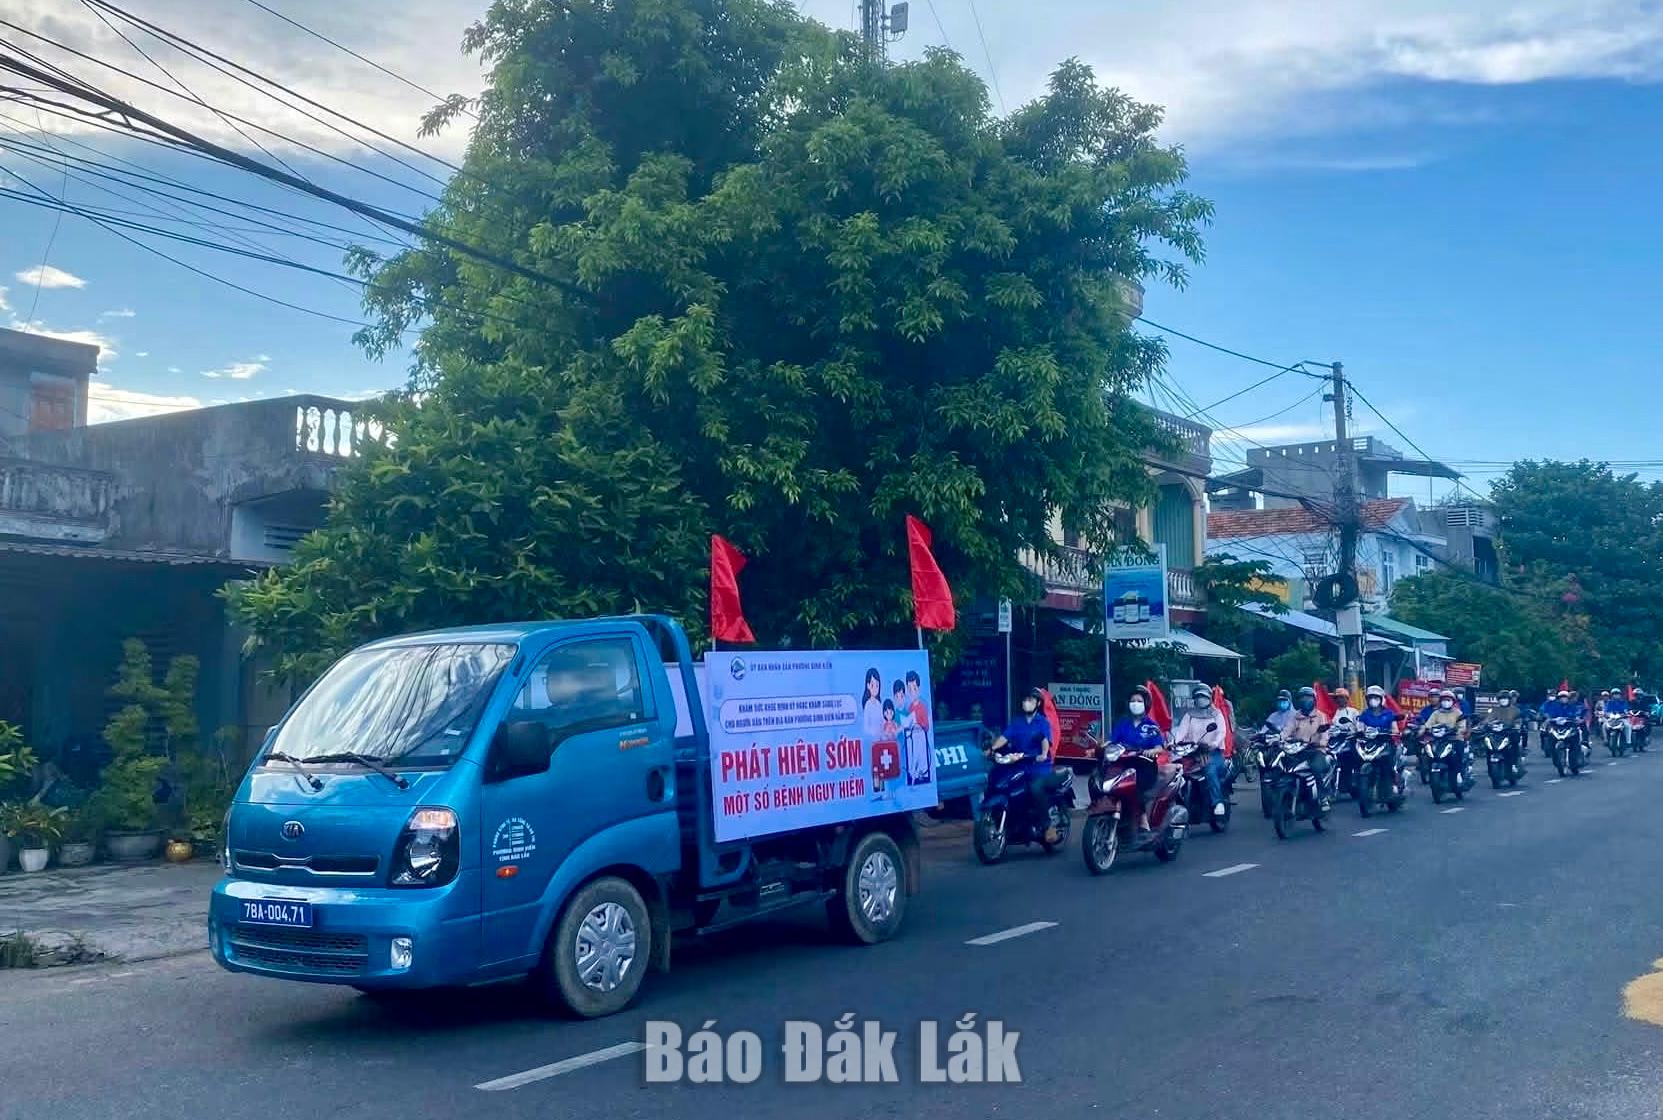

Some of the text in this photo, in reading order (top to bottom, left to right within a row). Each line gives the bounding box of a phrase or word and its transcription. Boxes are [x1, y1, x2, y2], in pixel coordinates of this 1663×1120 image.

[721, 734, 862, 783] PHÁT HIỆN SỚM
[723, 772, 864, 818] MỘT SỐ BỆNH NGUY HIỂM
